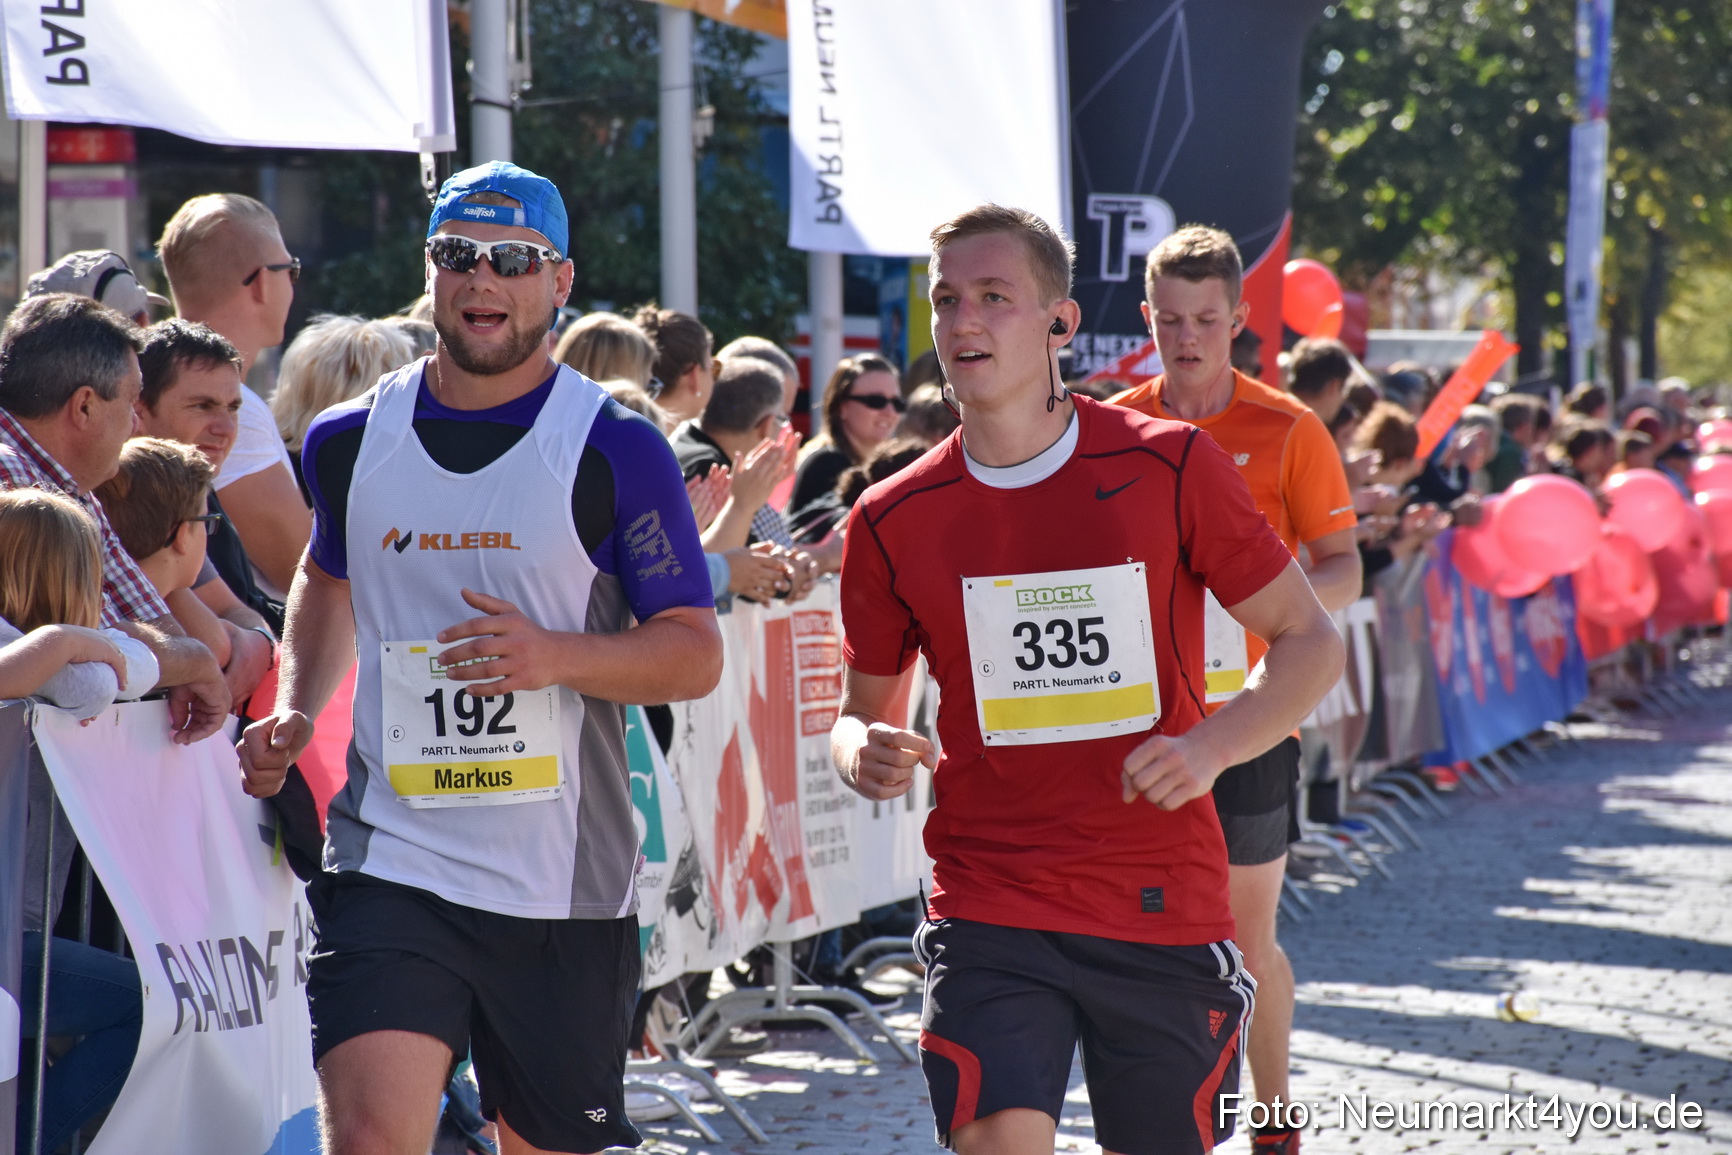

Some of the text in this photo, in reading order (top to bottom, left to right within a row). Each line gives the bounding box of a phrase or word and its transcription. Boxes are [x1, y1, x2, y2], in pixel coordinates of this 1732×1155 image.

[463, 207, 496, 218] sailfish
[419, 532, 521, 550] KLEBL
[1016, 584, 1095, 606] BOCK
[1018, 606, 1041, 614] inspired
[1051, 603, 1069, 611] smart
[1070, 602, 1097, 610] concepts
[1012, 616, 1110, 671] 335
[1013, 675, 1104, 690] PARTL Neumarkt
[424, 688, 516, 737] 192
[421, 744, 509, 756] PARTL Neumarkt
[434, 768, 513, 789] Markus
